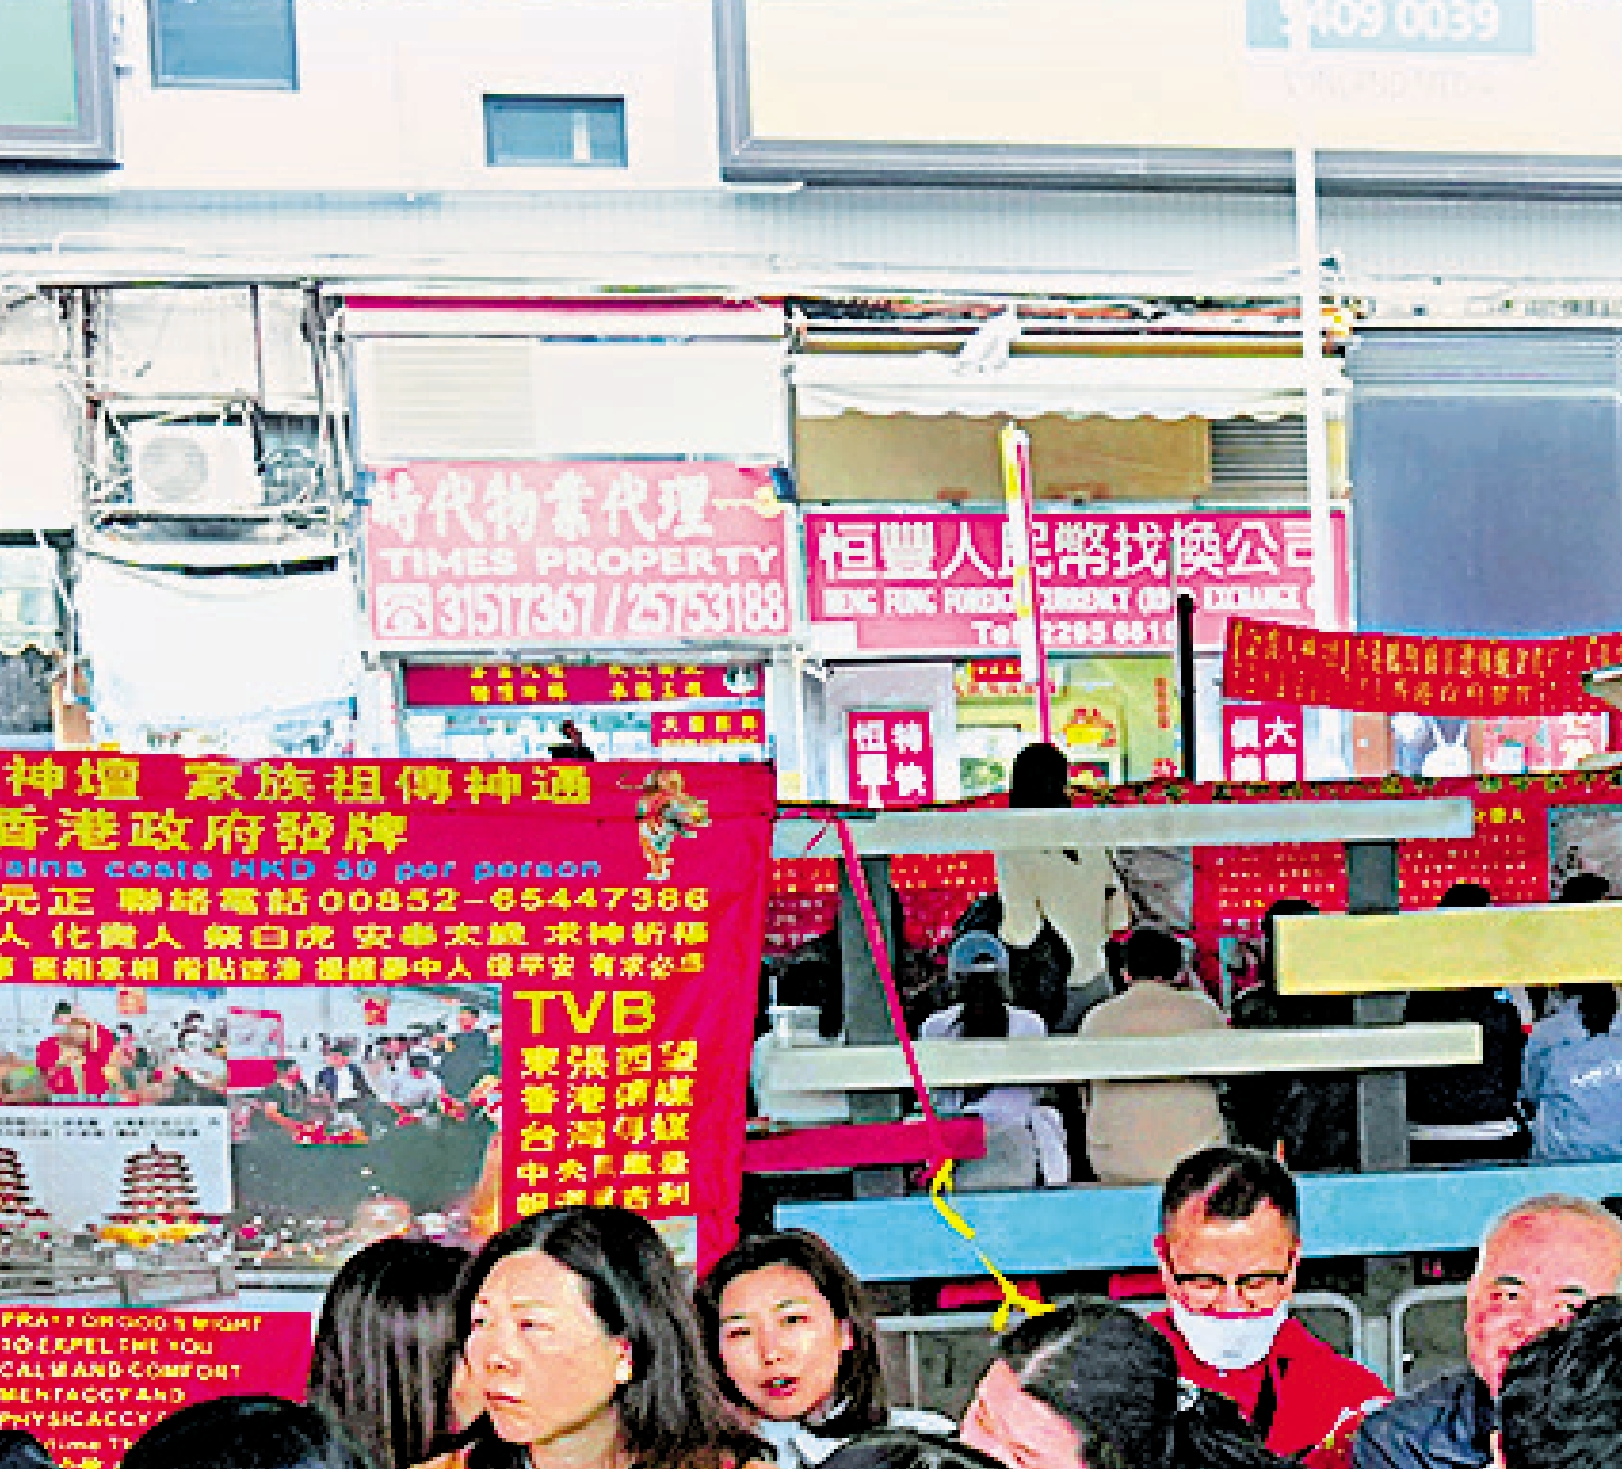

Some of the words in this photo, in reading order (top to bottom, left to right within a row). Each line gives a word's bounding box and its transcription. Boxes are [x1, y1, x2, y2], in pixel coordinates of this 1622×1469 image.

[373, 470, 715, 544] 時代物業代理
[380, 546, 518, 578] TIMES
[536, 545, 778, 578] PROPERTY
[184, 760, 592, 804] 家族祖傳神通
[105, 858, 212, 879] costs
[231, 858, 315, 878] HKD
[334, 858, 377, 879] 50
[397, 859, 456, 884] per
[474, 859, 601, 884] person
[513, 990, 658, 1035] TVB
[519, 1040, 700, 1080] 東張西望
